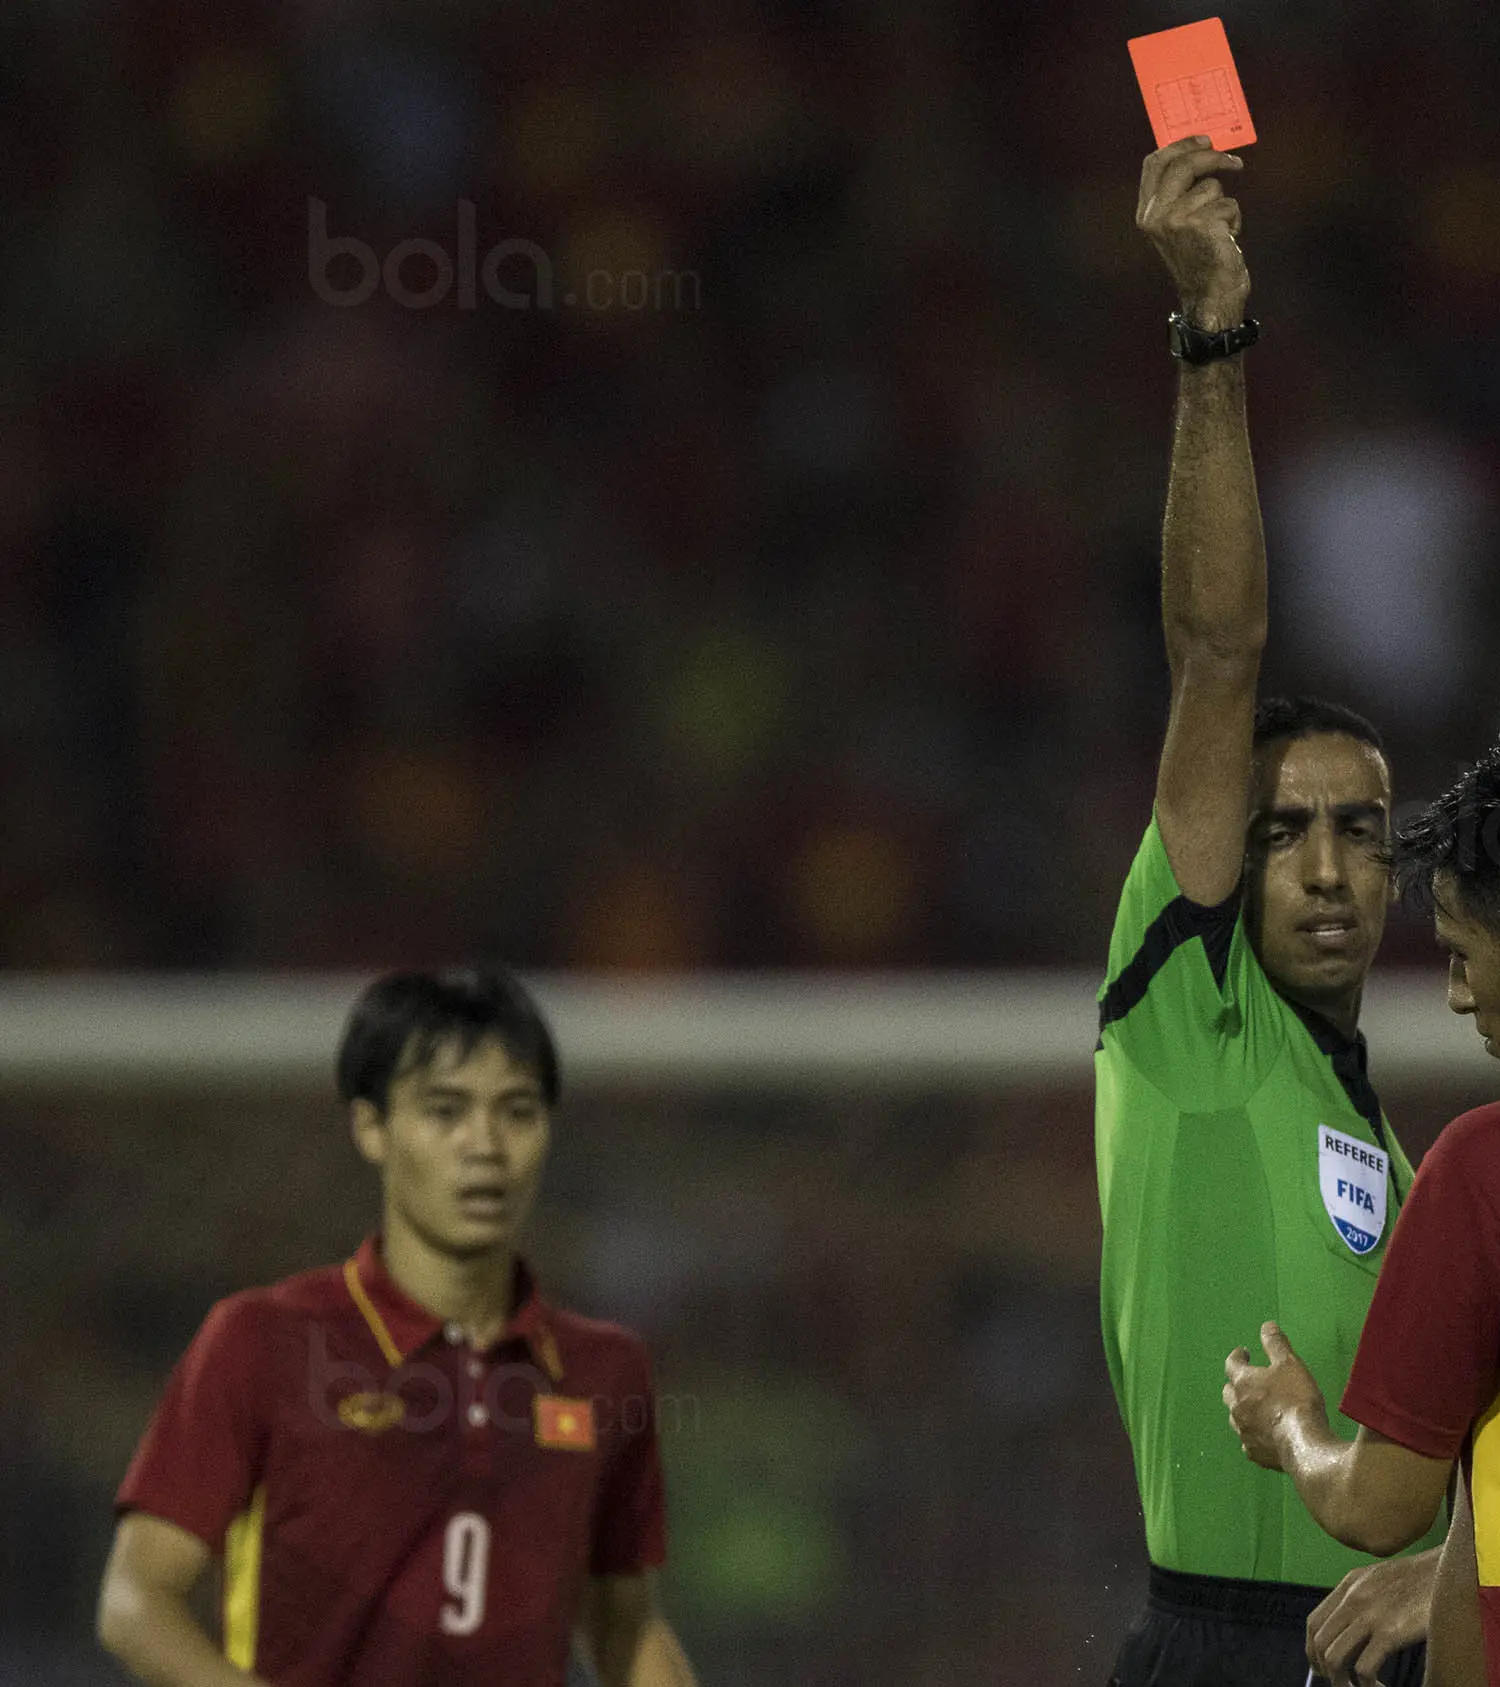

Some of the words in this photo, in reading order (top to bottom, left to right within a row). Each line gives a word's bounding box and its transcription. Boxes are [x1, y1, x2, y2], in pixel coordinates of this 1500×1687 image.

[1325, 1134, 1384, 1173] REFEREE
[1337, 1178, 1375, 1214] FIFA
[1346, 1227, 1369, 1248] 2017
[440, 1511, 490, 1636] 9
